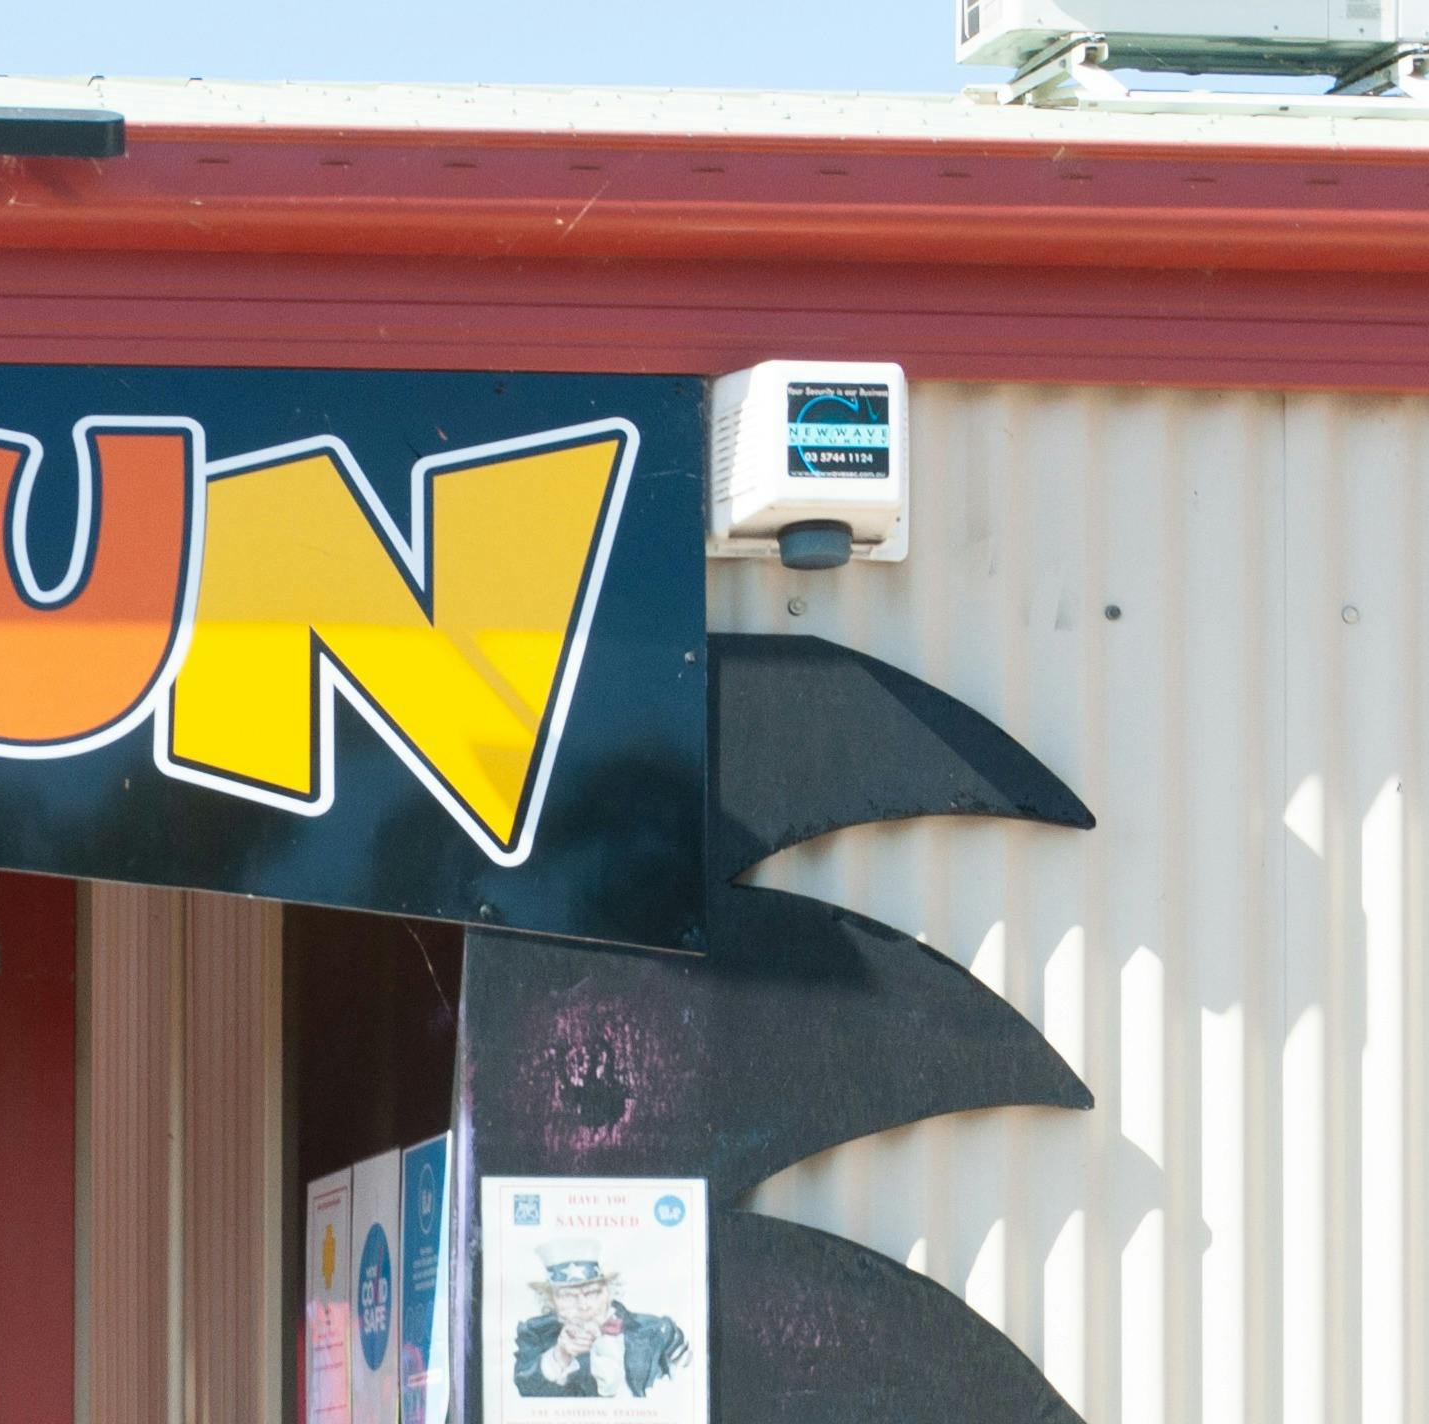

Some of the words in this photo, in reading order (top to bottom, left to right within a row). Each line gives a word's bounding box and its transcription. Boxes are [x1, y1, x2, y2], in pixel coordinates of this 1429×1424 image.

[805, 386, 834, 397] Security
[859, 387, 888, 397] Business
[556, 1215, 640, 1227] SANITISED
